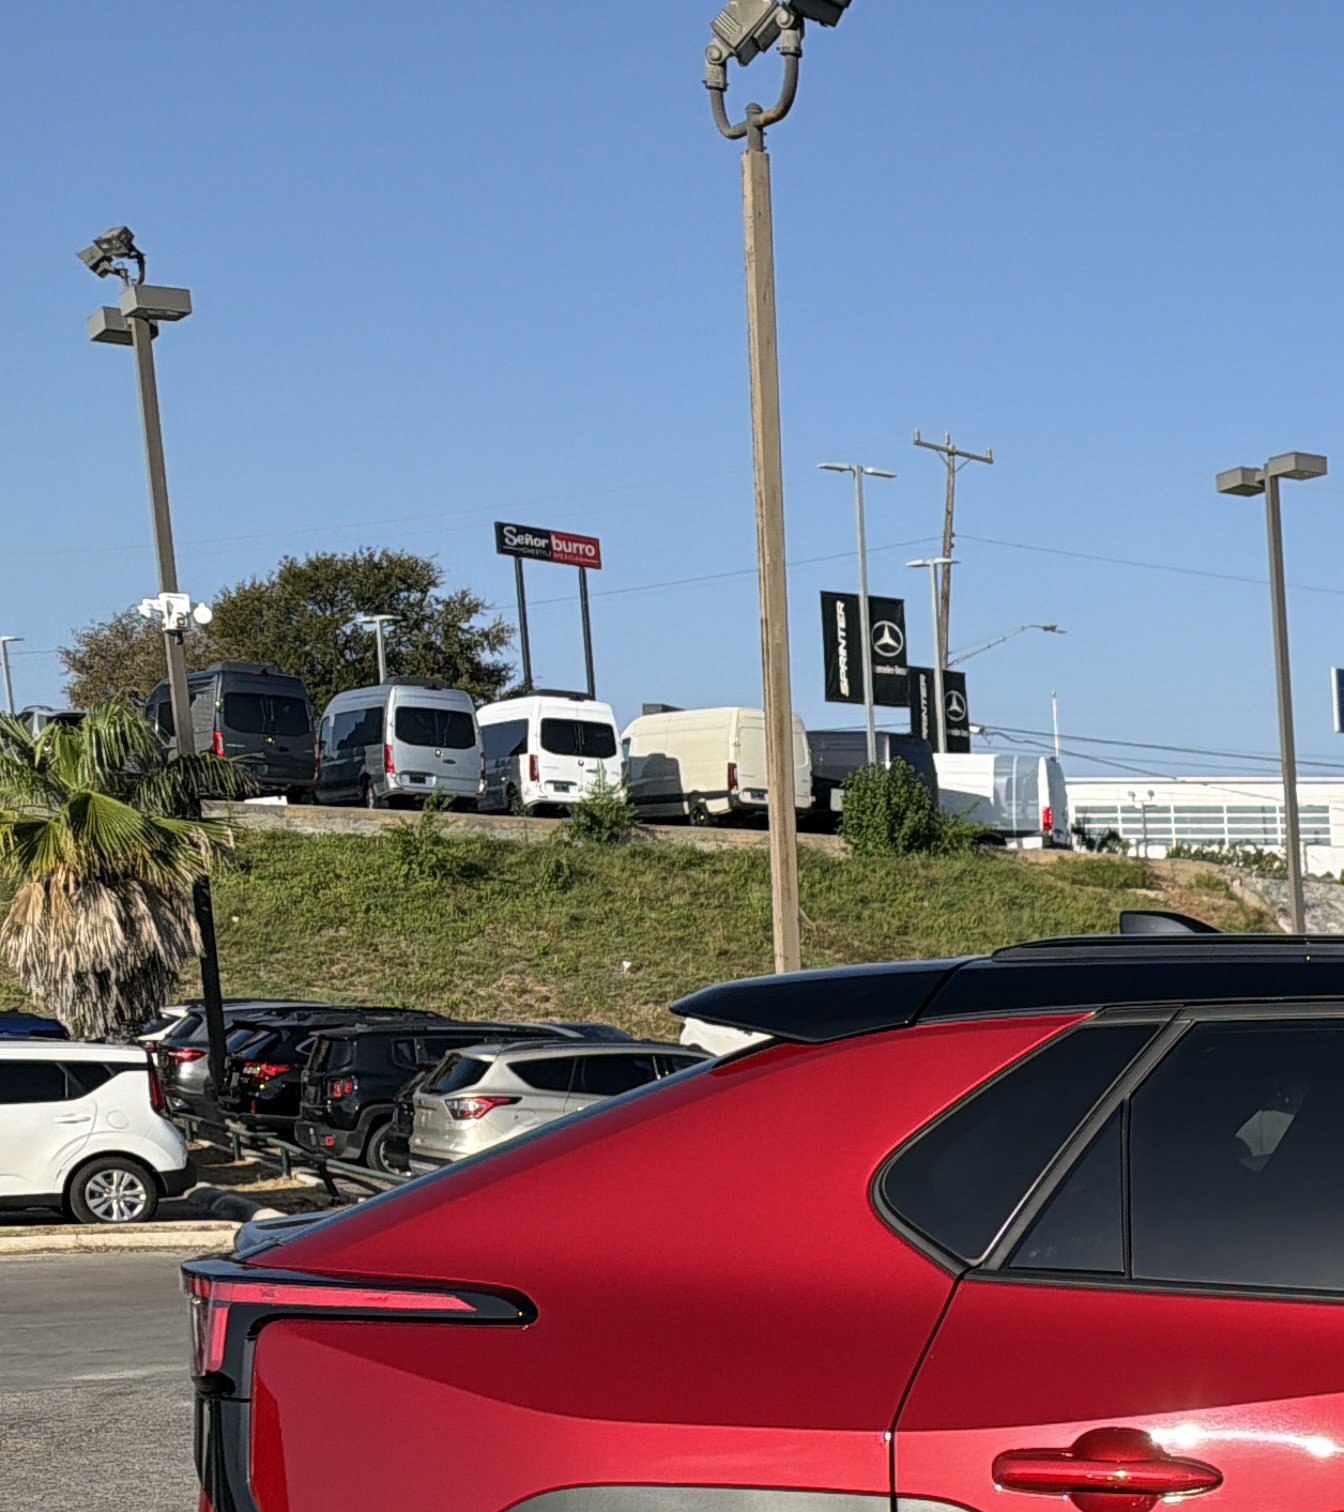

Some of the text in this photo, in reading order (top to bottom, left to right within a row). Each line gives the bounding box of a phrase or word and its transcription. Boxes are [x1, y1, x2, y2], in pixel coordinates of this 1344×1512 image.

[503, 526, 596, 557] Señor burro
[836, 600, 849, 697] SPRINTER
